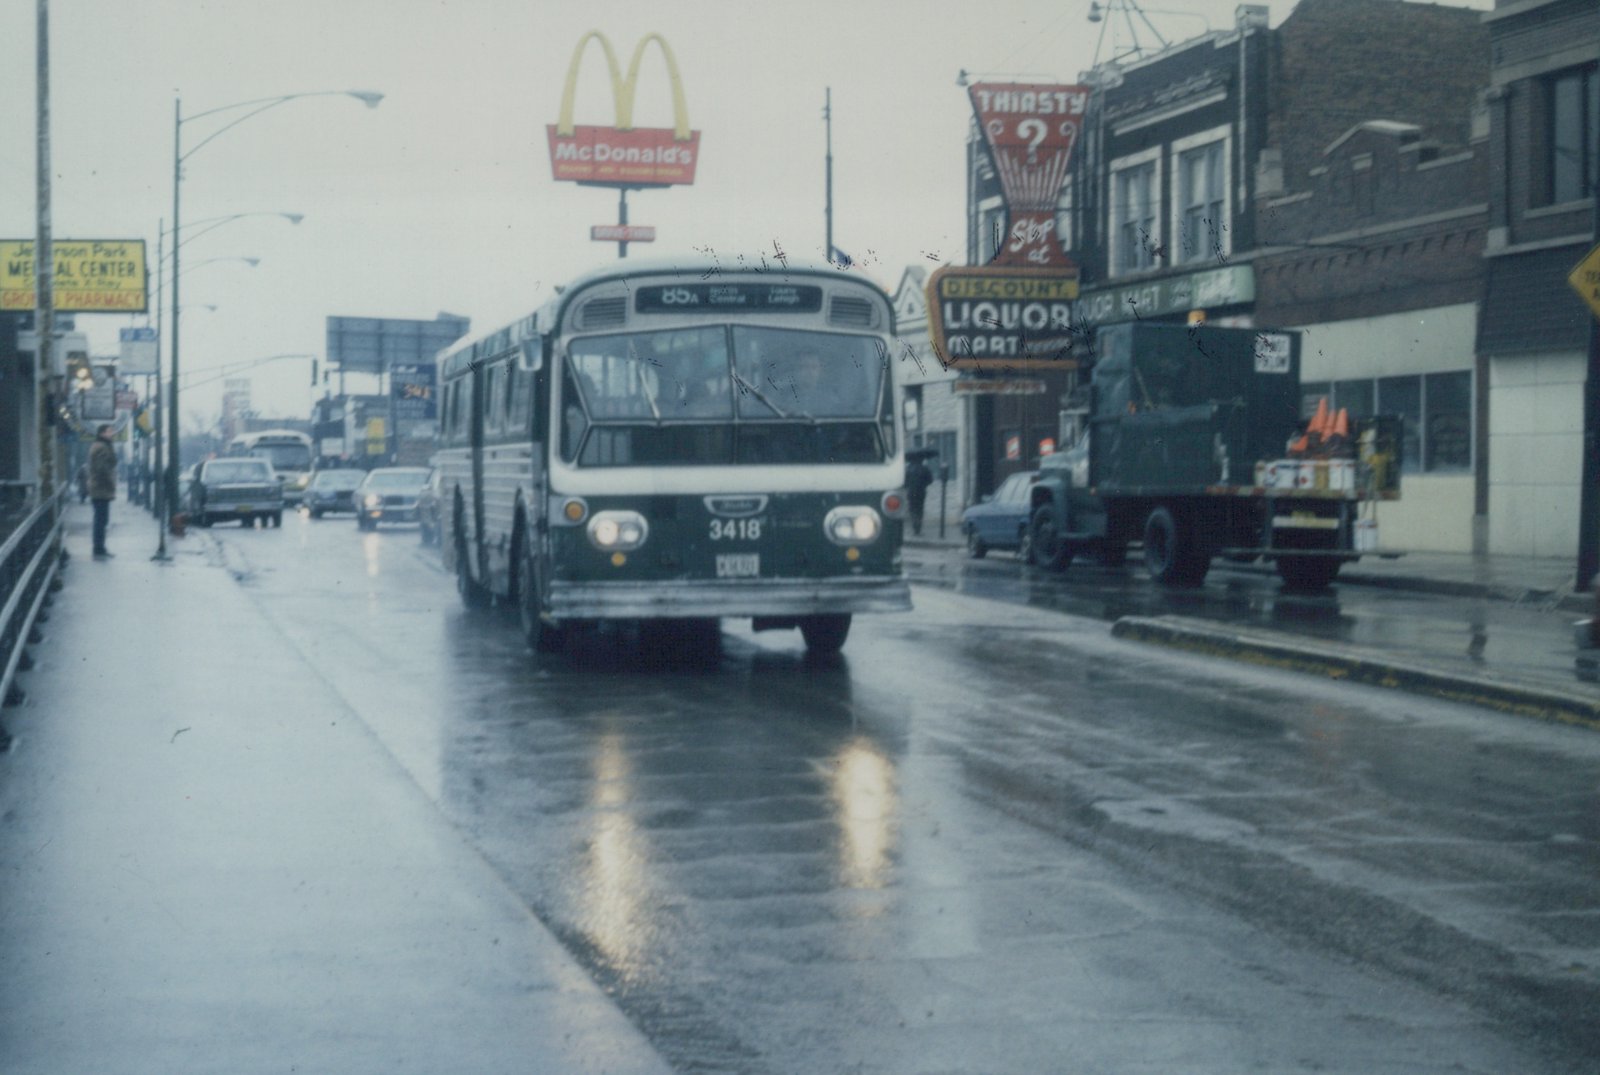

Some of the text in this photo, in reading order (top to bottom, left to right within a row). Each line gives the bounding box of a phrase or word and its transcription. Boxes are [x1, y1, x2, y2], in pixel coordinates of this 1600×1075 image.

[977, 90, 1087, 115] THIRSTY
[555, 142, 692, 165] McDonald's
[1009, 217, 1056, 252] Stop
[92, 242, 126, 257] Park
[1028, 246, 1051, 264] at
[8, 261, 136, 278] MEAL CENTER
[947, 279, 1065, 297] DISCOUNT
[944, 302, 1071, 331] LIQUOR
[947, 335, 1020, 356] MART
[709, 519, 761, 540] 3418
